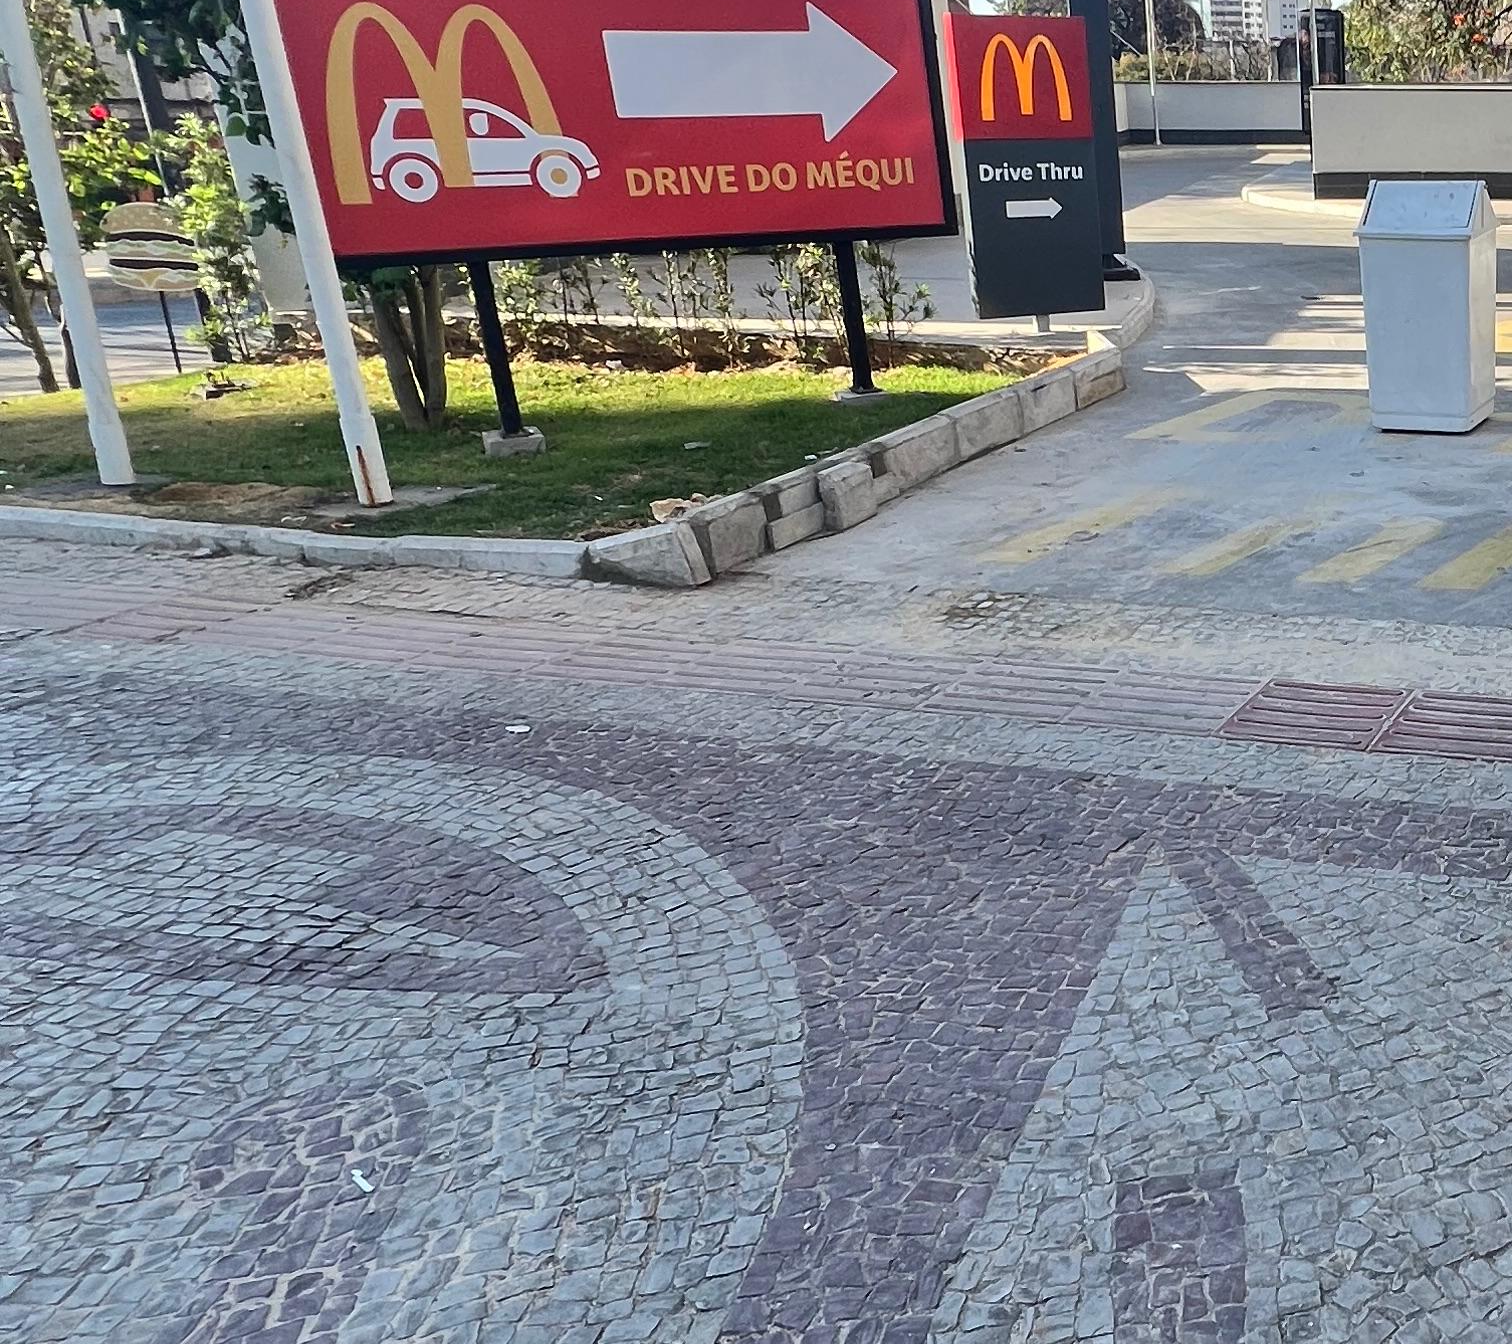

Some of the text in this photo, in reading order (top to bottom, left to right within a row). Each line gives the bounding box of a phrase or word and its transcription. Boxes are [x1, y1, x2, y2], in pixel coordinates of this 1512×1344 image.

[625, 150, 915, 198] DRIVE DO MÉQUI
[978, 162, 1084, 182] Drive Thru
